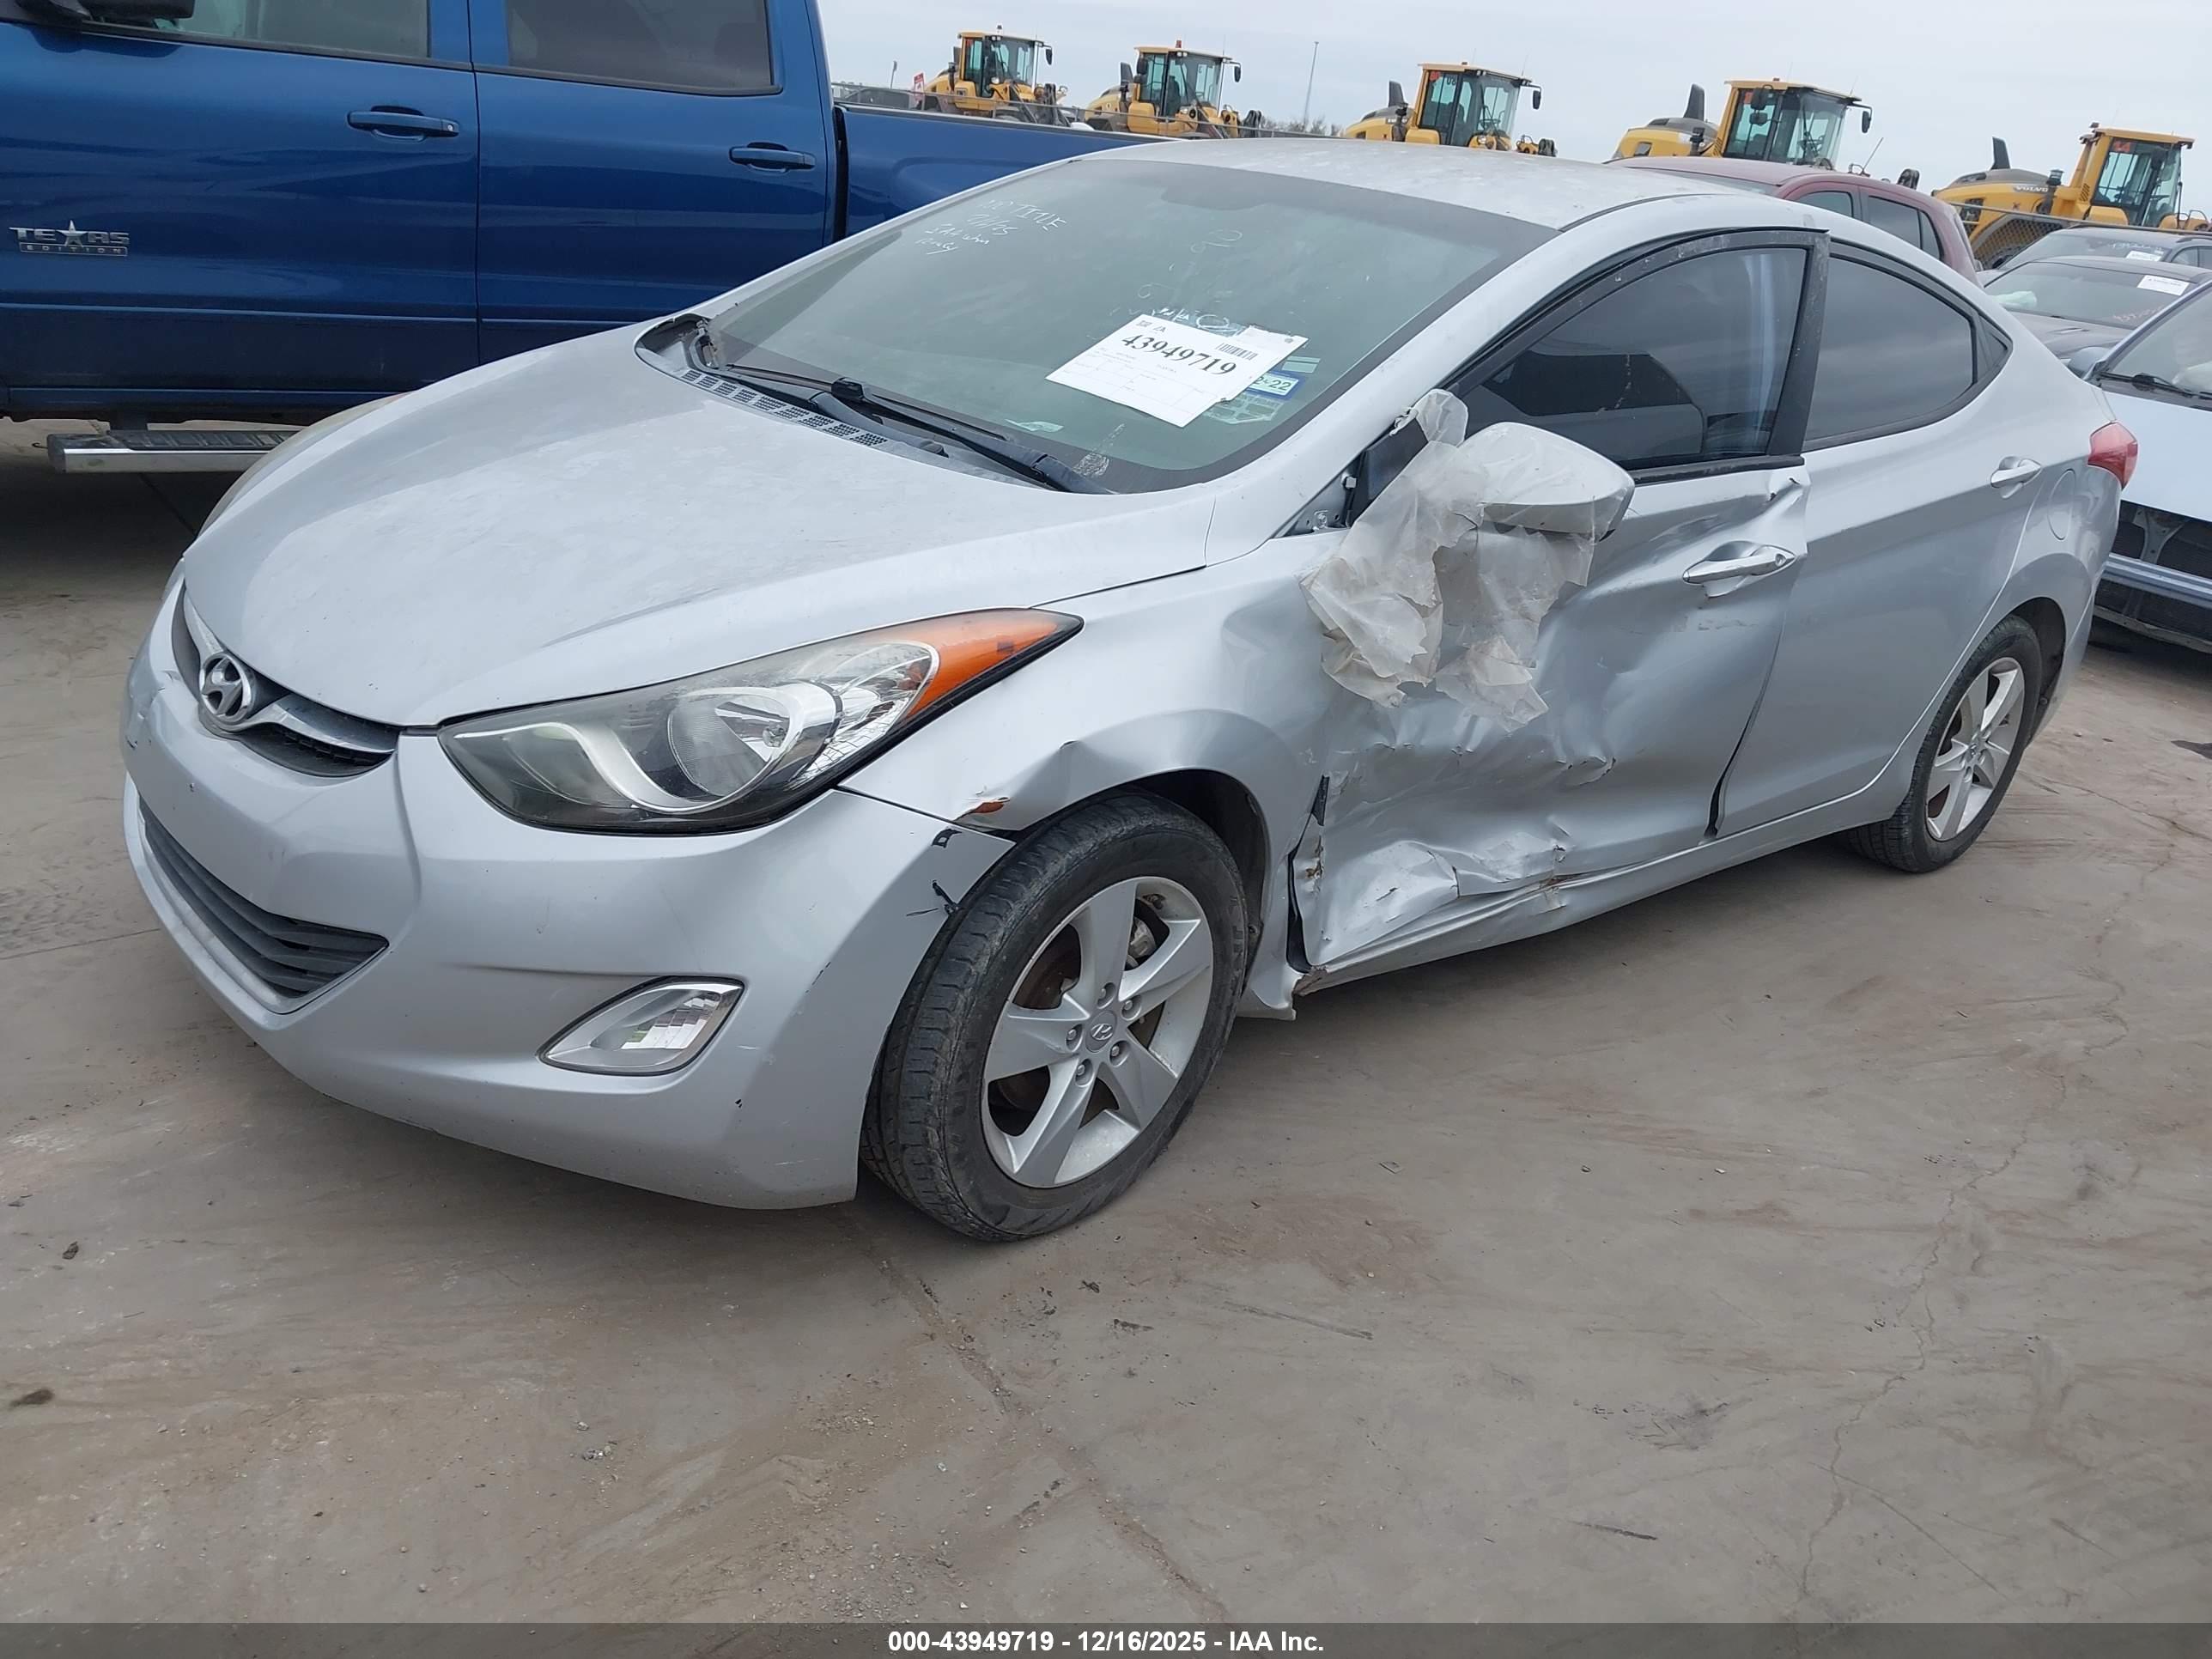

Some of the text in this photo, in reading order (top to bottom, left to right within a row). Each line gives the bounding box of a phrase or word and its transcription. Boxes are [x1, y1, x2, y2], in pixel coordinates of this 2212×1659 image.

[1012, 203, 1067, 232] TITLE
[9, 219, 130, 247] TEXAS
[27, 244, 121, 254] EDITION
[1121, 333, 1237, 375] 43949719
